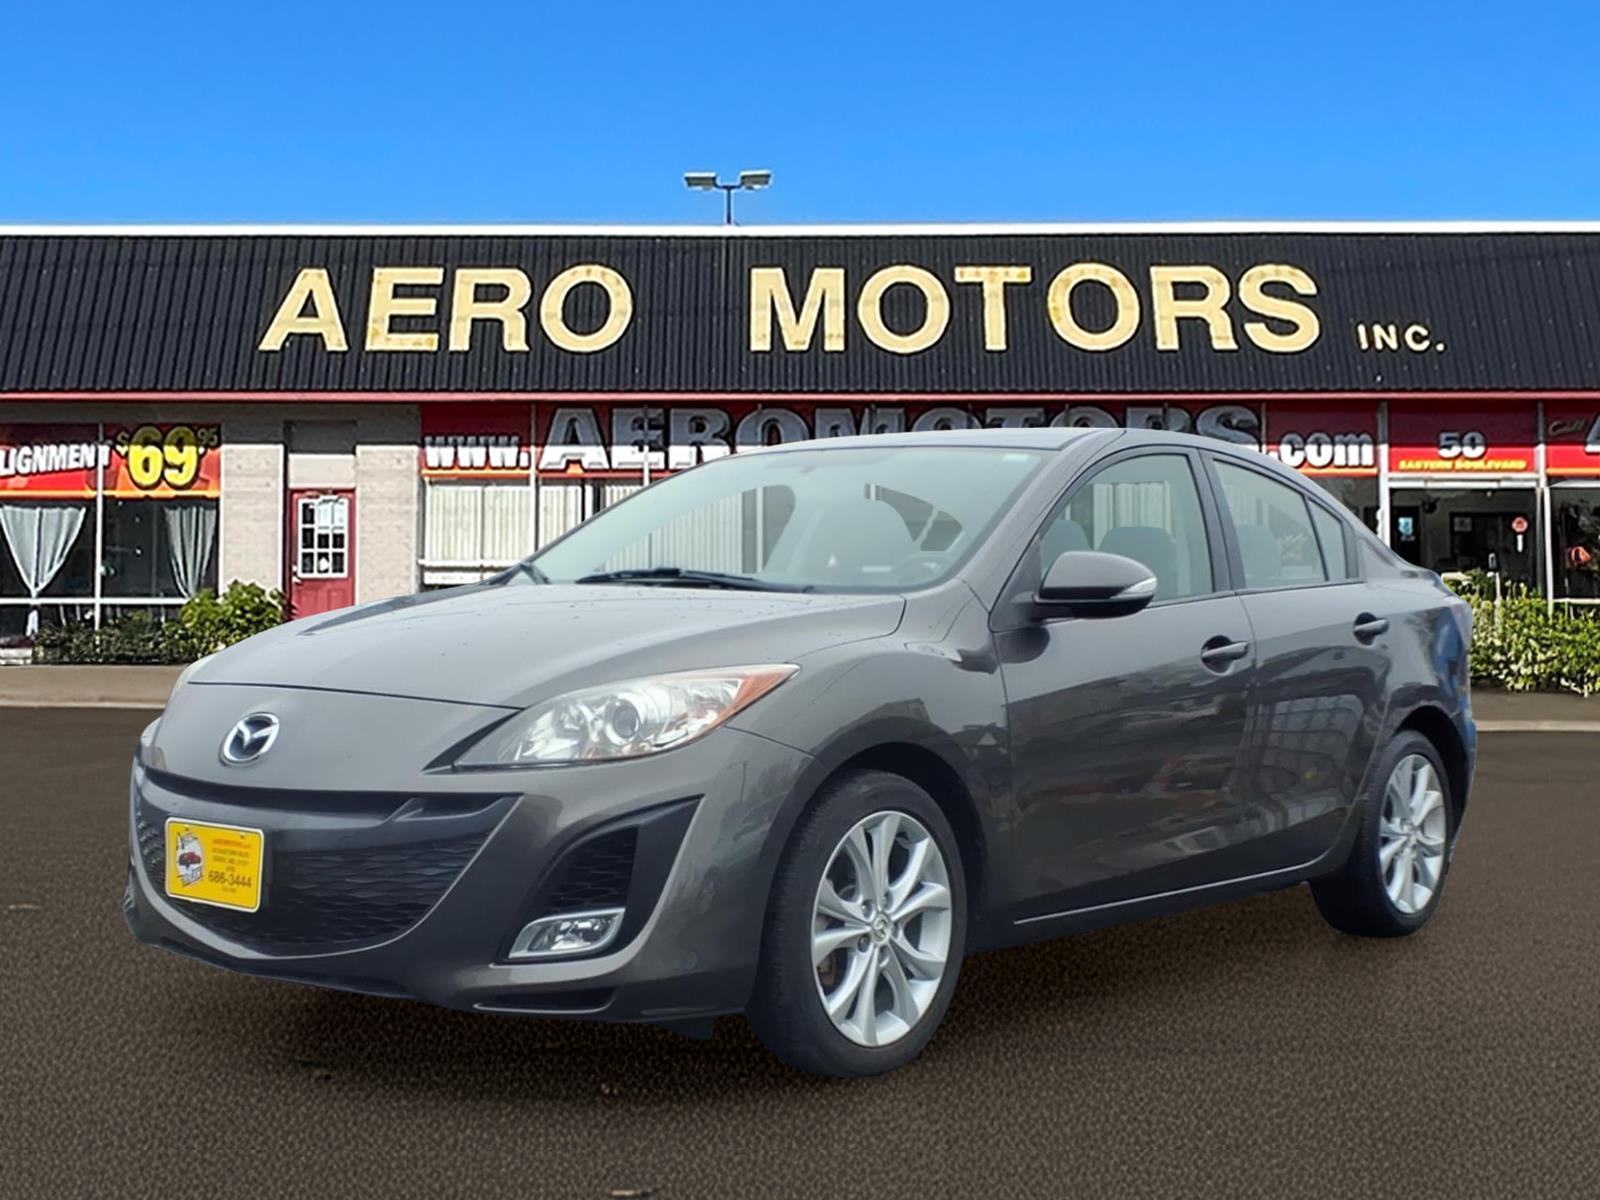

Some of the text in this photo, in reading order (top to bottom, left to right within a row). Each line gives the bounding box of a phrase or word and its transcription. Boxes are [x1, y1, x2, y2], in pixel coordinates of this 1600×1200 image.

[258, 263, 1446, 354] AERO MOTORS INC.
[1438, 431, 1486, 460] 50
[1399, 460, 1527, 470] EASTERN BOULEVARD
